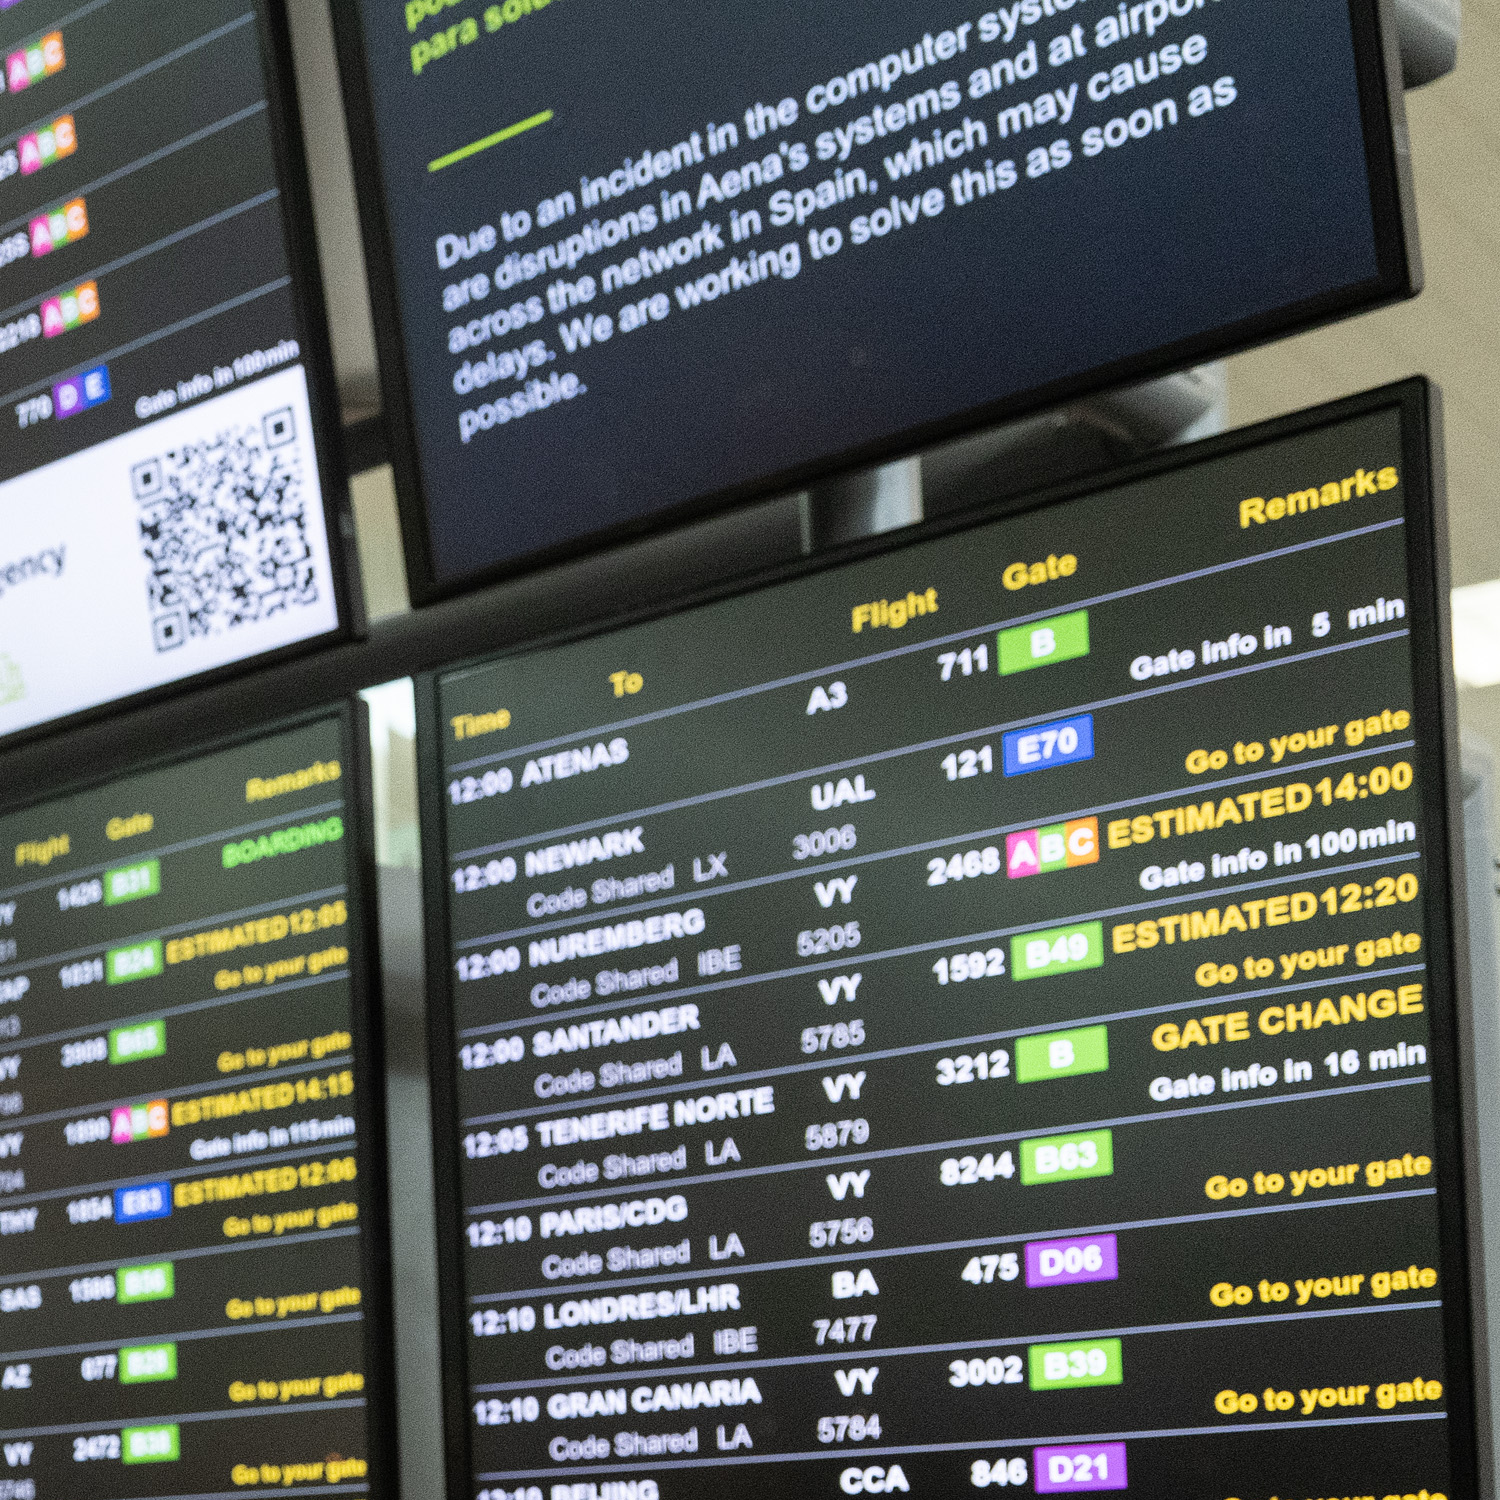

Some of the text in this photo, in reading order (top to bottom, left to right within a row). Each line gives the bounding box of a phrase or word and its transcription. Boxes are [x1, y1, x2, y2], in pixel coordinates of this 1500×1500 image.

[410, 17, 480, 76] para
[434, 223, 497, 270] Due
[498, 209, 532, 242] to
[535, 189, 576, 228] an
[579, 131, 705, 209] incident
[705, 121, 739, 156] in
[742, 96, 799, 140] the
[804, 20, 972, 114] computer
[441, 271, 490, 312] are
[492, 203, 659, 290] disruptions
[659, 189, 692, 223] in
[695, 140, 810, 210] Aena's
[813, 79, 962, 161] systems
[967, 39, 1039, 99] and
[1047, 22, 1087, 67] at
[446, 32, 1208, 354] across the network in Spain, which may cause
[451, 74, 1238, 395] delays. We are working to solve this as soon as
[457, 370, 587, 444] possible.
[450, 465, 1399, 740] Time To Flight Gate Remarks
[1128, 596, 1405, 681] Gate info in 5 min
[448, 626, 1057, 804] 12:00 ATENAS A3 711 B
[14, 833, 70, 865] Flight
[105, 812, 154, 841] Gate
[244, 759, 341, 802] Remarks
[220, 815, 344, 869] BOARDING
[452, 725, 1079, 892] 12:00 NEWARK UAL 121 E70
[525, 708, 1411, 918] Code Shared LX 3006 Go to your gate
[164, 914, 290, 964] ESTIMATED
[213, 945, 348, 991] Go to your gate
[459, 871, 1419, 1069] 12:00 SANTANDER VY 1592 B49 ESTIMATED 12:20
[462, 982, 1424, 1158] 12:05 TENERIFE NORTE VY 3212 B GATE CHANGE
[466, 1138, 1099, 1247] 12:10 PARIS/CDG VY 8244 B63
[470, 1243, 1103, 1336] 12:10 LONDRES/LHR BA 475 D06
[473, 1346, 1108, 1425] 12:10 GRAN CANARIA VY 3002 B39
[838, 1463, 910, 1495] CCA
[970, 1456, 1028, 1488] 846
[1046, 1451, 1109, 1484] D21
